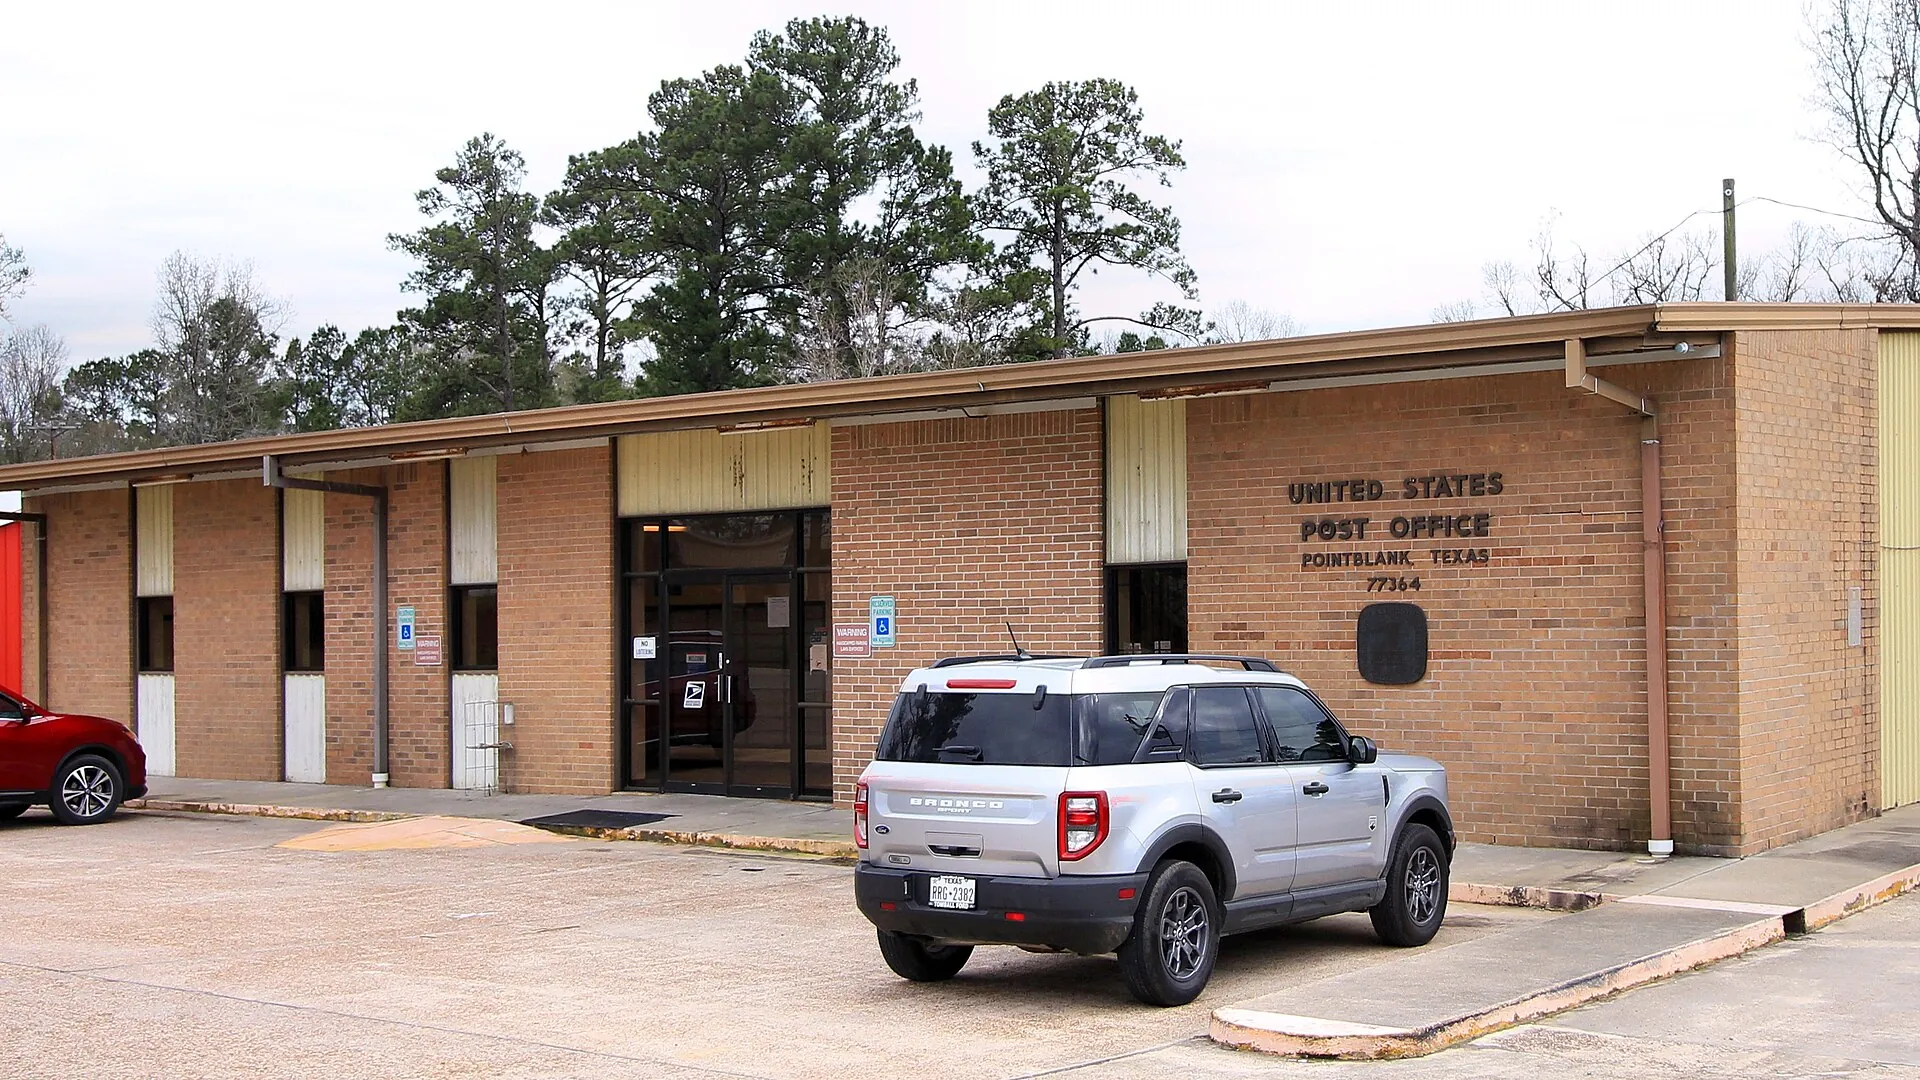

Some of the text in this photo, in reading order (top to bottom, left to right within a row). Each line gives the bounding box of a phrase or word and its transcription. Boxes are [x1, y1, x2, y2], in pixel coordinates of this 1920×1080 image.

[1288, 472, 1504, 504] UNITED STATES
[1301, 513, 1490, 542] POST OFFICE
[1301, 549, 1489, 567] POINTBLANK, TEXAS
[1366, 576, 1421, 592] 77364
[909, 797, 1005, 809] BRONCO
